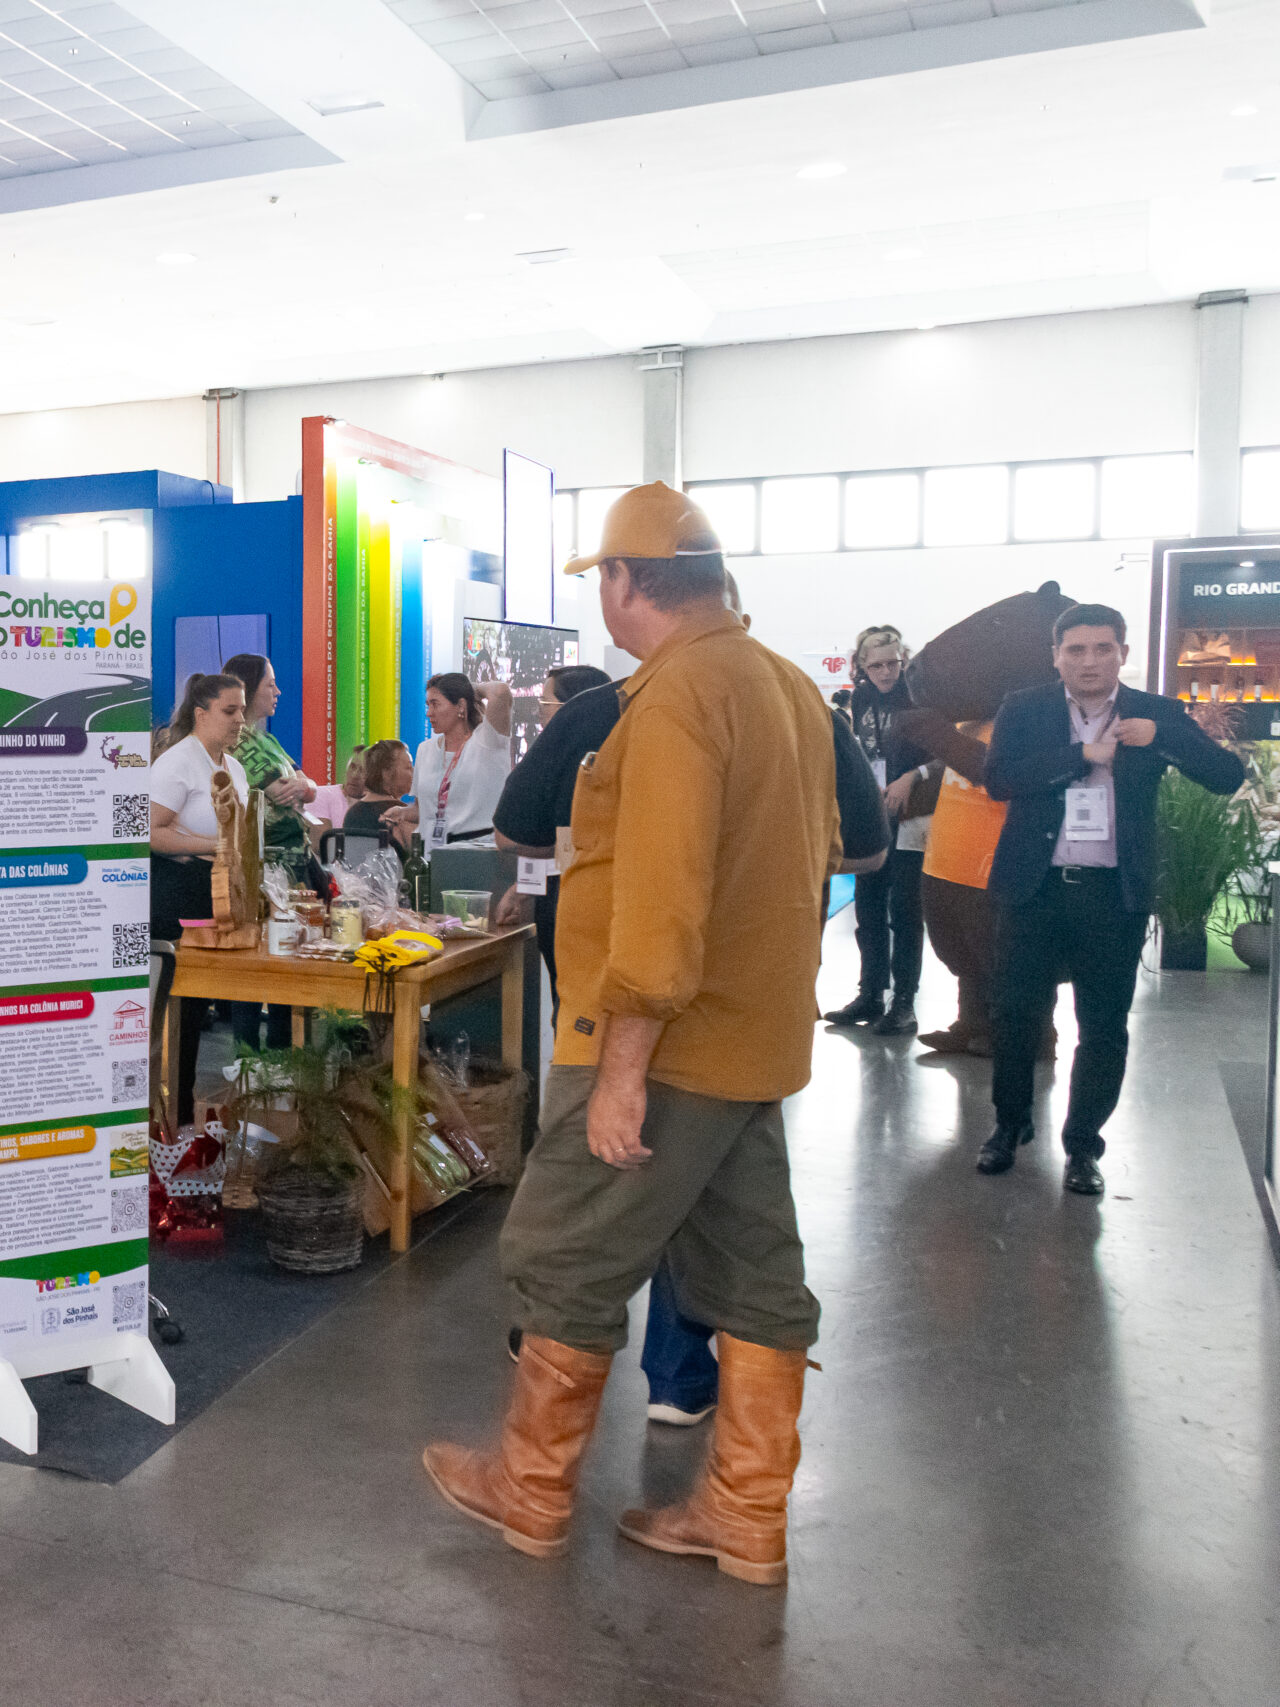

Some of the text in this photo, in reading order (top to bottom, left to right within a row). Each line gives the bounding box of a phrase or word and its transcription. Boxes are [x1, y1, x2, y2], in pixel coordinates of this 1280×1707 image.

[328, 563, 333, 581] DA
[1194, 583, 1222, 596] RIO
[10, 626, 111, 648] TURISMO
[114, 623, 146, 649] de
[26, 650, 56, 660] José
[64, 651, 87, 661] dos
[328, 641, 333, 661] DO
[327, 722, 332, 742] DO
[26, 735, 37, 747] DO
[39, 734, 65, 746] VINHO
[9, 865, 25, 878] DAS
[28, 862, 68, 877] COLÔNIAS
[102, 870, 148, 883] COLÔNIAS
[19, 1003, 28, 1014] DA
[30, 1001, 58, 1014] COLÔNIA
[60, 999, 83, 1011] MURICI
[109, 1031, 147, 1041] CAMINHOS
[20, 1133, 49, 1146] SABORES
[52, 1132, 56, 1143] E
[57, 1129, 84, 1142] AROMAS
[36, 1270, 100, 1293] TURISMO
[66, 1304, 95, 1316] São José
[63, 1317, 74, 1325] dos
[75, 1312, 98, 1322] Pinhais
